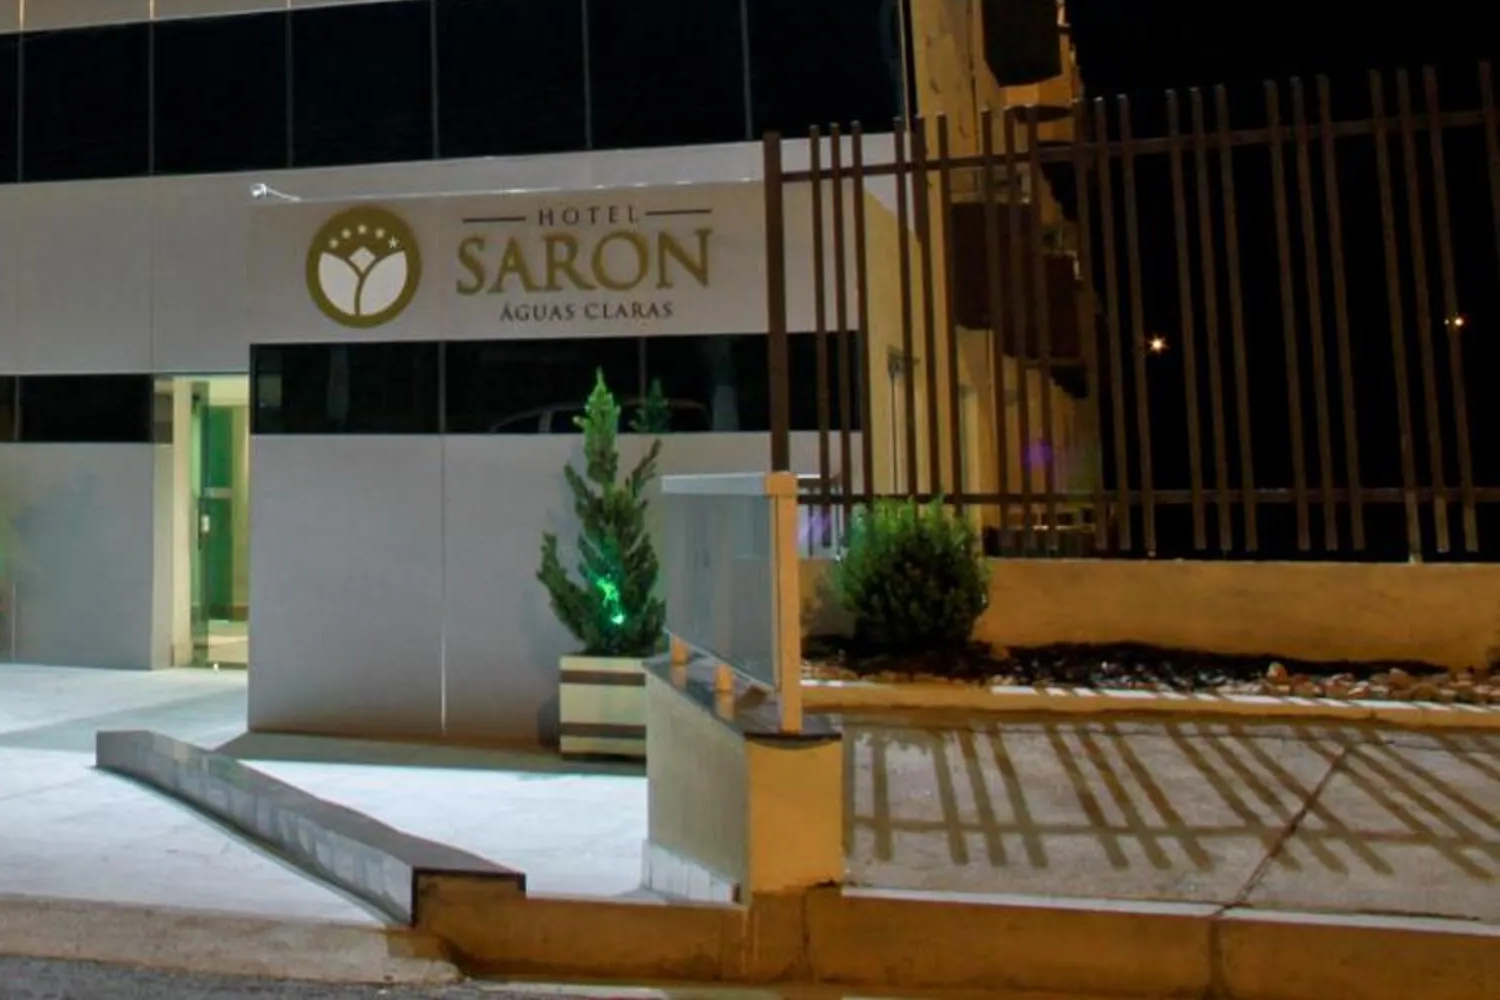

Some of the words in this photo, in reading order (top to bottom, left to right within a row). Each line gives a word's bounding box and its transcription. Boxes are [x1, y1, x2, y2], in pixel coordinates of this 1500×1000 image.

[537, 205, 640, 227] HOTEL
[456, 227, 714, 296] SARON
[499, 300, 575, 322] ÁGUAS
[584, 301, 673, 320] CLARAS
